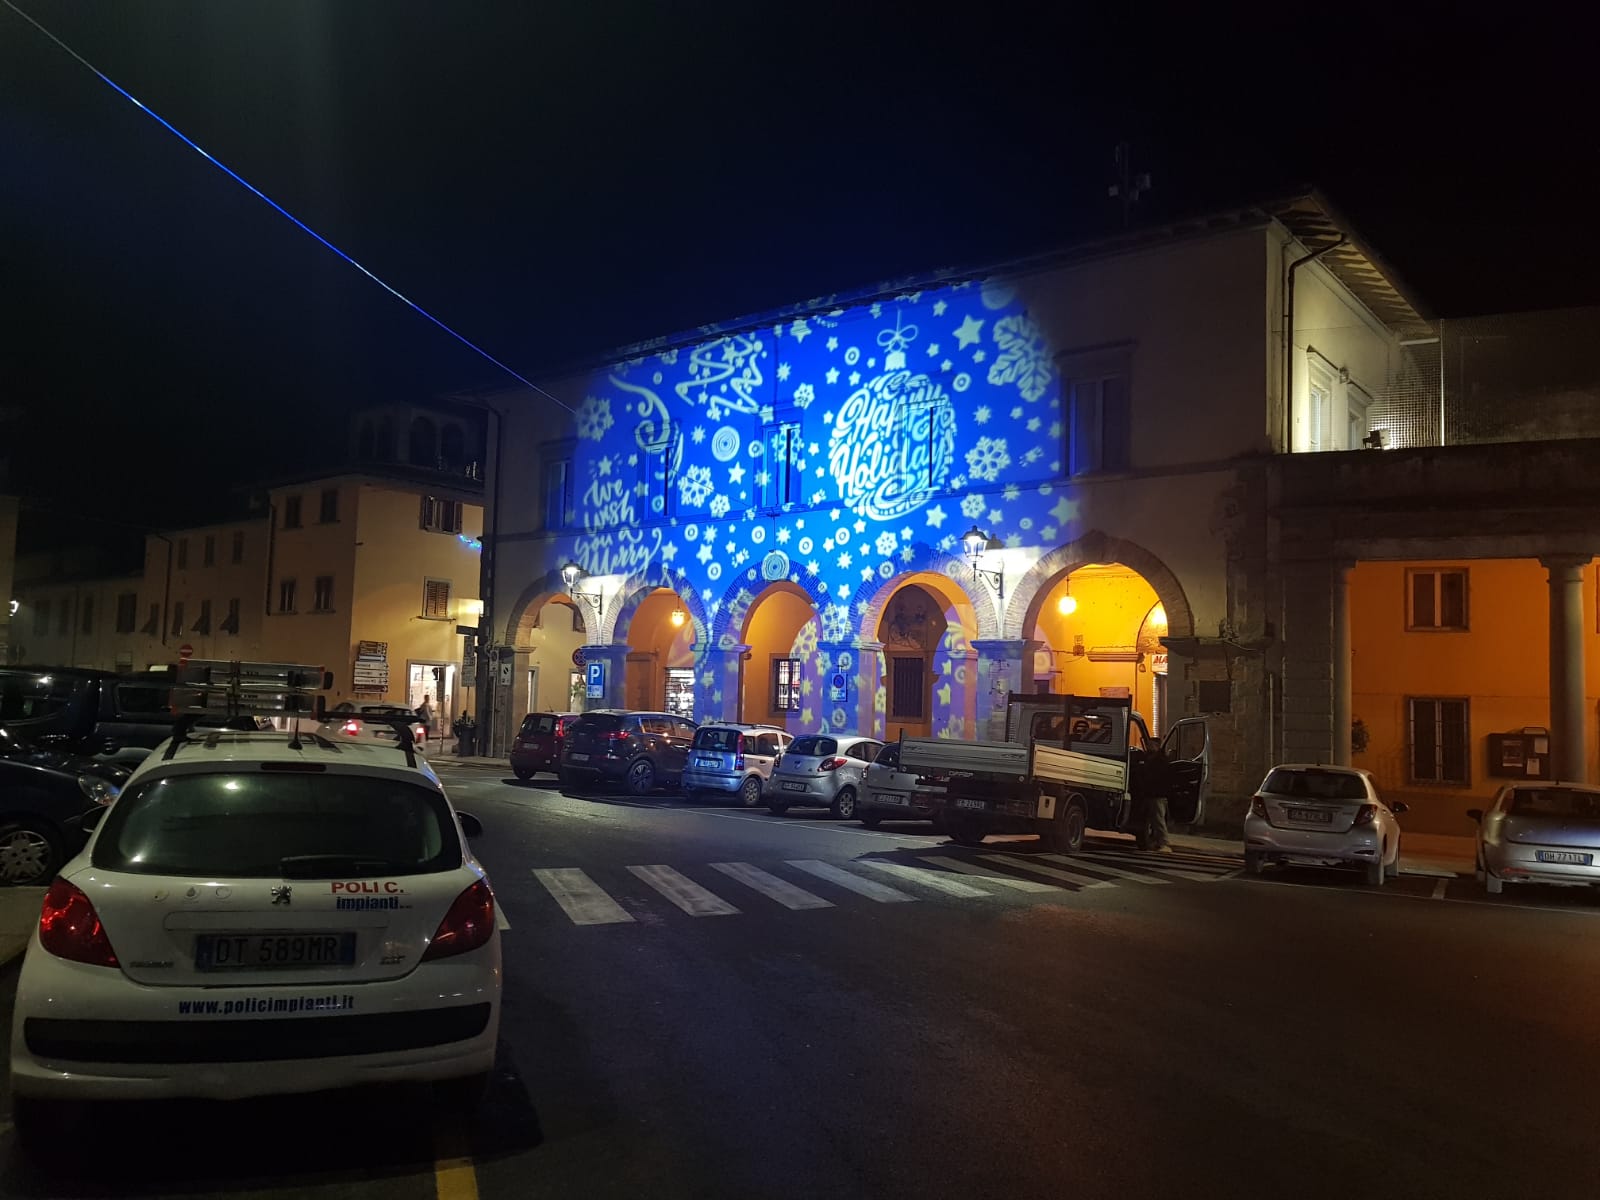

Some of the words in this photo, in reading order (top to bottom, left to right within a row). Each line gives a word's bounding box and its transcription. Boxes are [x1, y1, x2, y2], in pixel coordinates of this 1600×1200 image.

[590, 665, 600, 684] P
[331, 882, 379, 893] POLI
[384, 881, 404, 893] C.
[336, 896, 399, 911] impianti
[216, 938, 249, 963] DT
[259, 937, 338, 962] 589MR
[178, 995, 354, 1014] www.policimpianti.it
